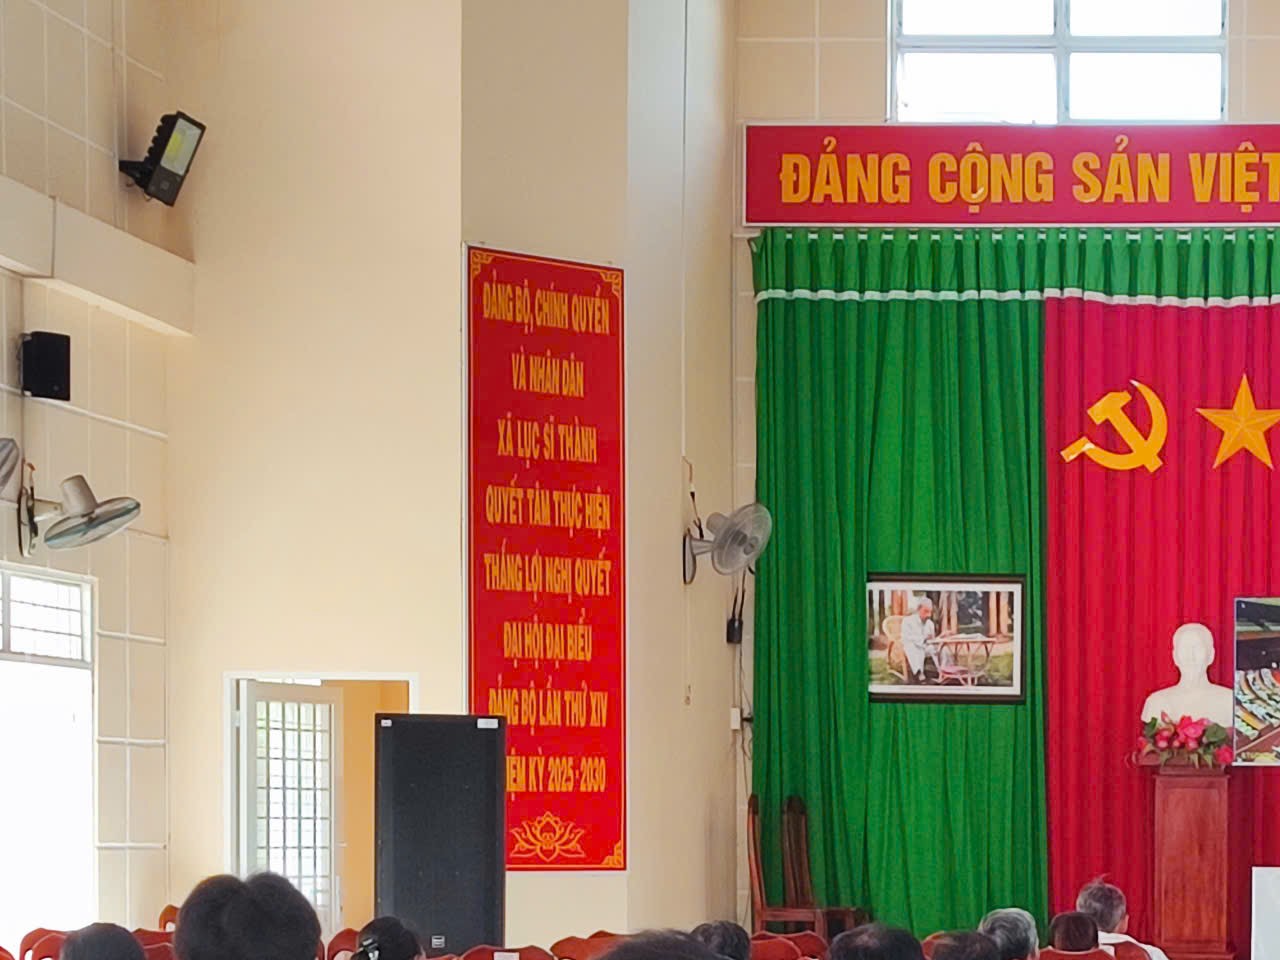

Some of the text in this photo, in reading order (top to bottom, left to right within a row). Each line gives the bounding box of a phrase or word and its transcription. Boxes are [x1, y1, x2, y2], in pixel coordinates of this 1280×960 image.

[780, 136, 910, 203] ĐẢNG
[929, 142, 1053, 213] CỘNG
[1072, 135, 1170, 203] SẢN
[483, 269, 513, 321] ĐẢNG
[535, 282, 568, 330] CHÍNH
[572, 285, 610, 335] QUYỀN
[512, 345, 584, 397] VÀ NHÂN DÂN
[517, 420, 540, 468] LỤC
[558, 416, 597, 463] THÀNH
[486, 474, 610, 538] QUYẾT TÂM THỰC HIỆN
[484, 538, 611, 603] THẮNG LỢI NGHỊ QUYẾT
[504, 608, 592, 669] ĐẠI HỘI ĐẠI BIỂU
[489, 674, 608, 735] ĐẢNG BỘ LẦN THỨ XIV
[506, 748, 526, 801] IỆM
[529, 747, 545, 792] KỲ
